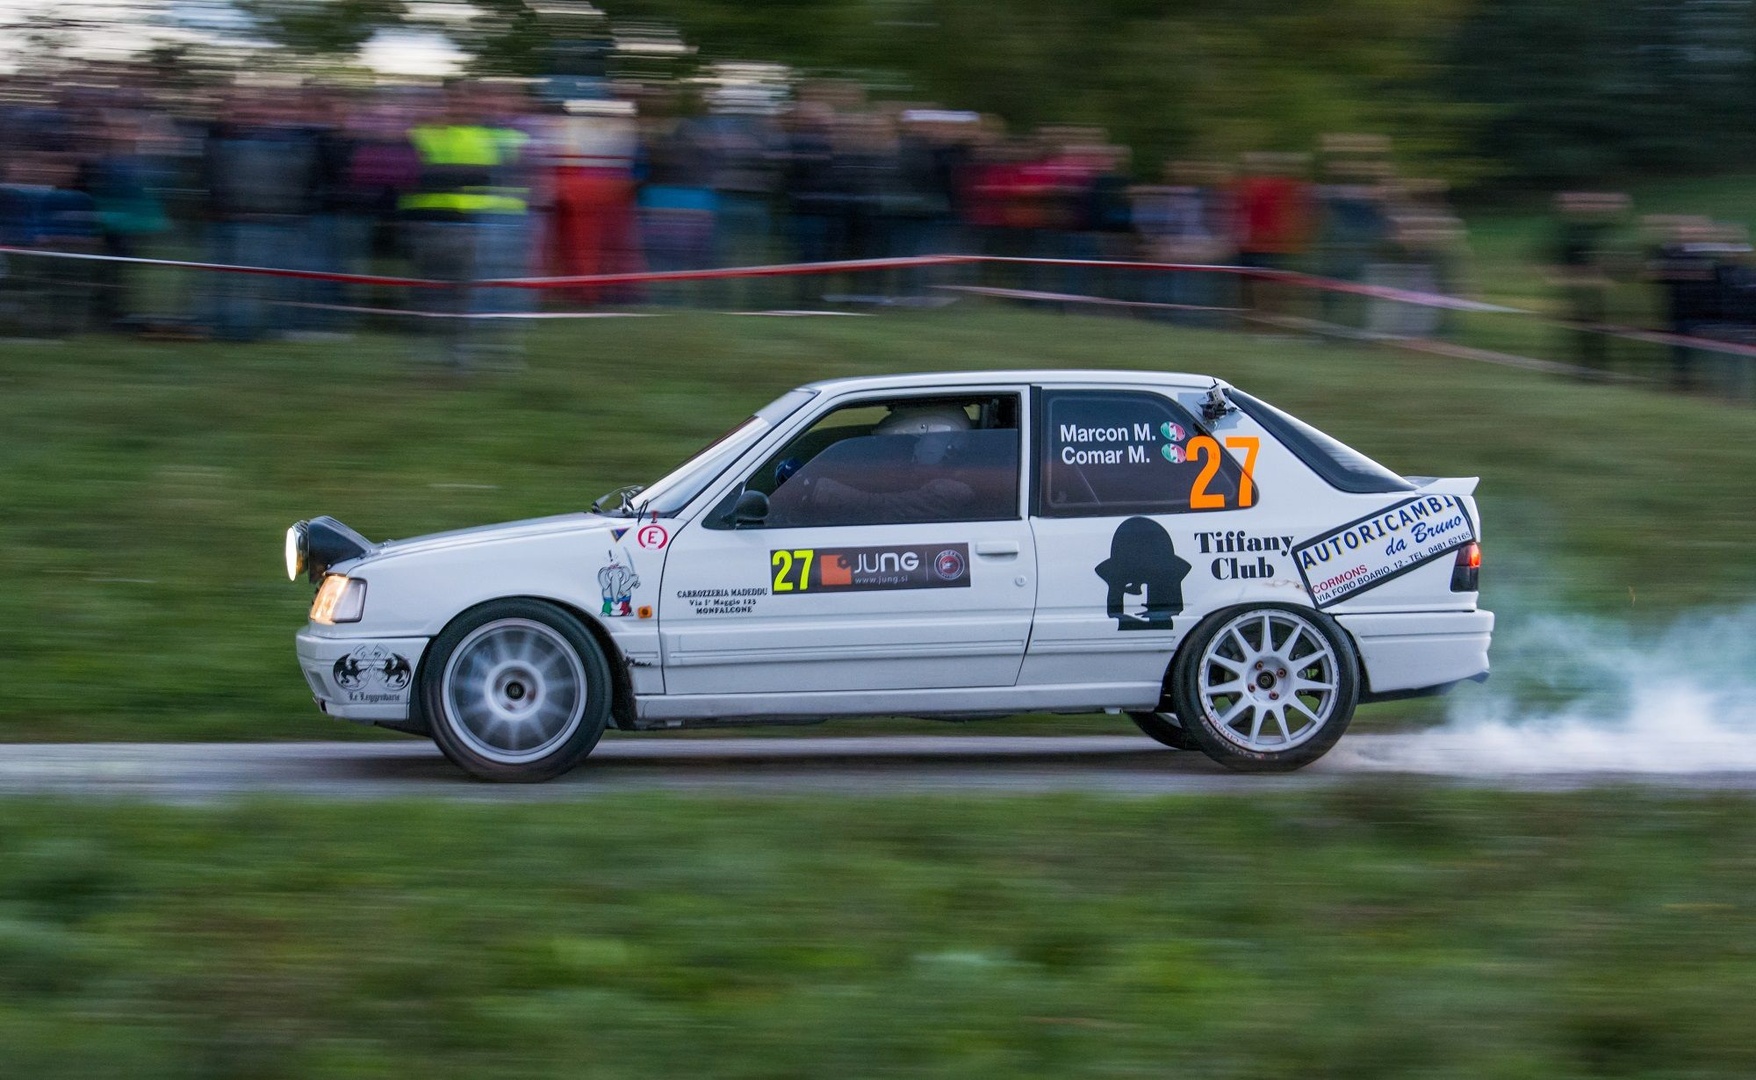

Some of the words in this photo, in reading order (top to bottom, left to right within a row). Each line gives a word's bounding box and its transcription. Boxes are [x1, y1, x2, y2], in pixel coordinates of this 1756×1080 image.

[1060, 424, 1128, 442] Marcon
[1133, 423, 1156, 441] M.
[1061, 446, 1123, 464] Comar
[1128, 445, 1150, 463] M.
[1186, 436, 1259, 508] 27
[1194, 530, 1294, 556] Tiffany
[1302, 496, 1453, 570] AUTORICAMBI
[1385, 536, 1408, 556] da
[1411, 514, 1463, 544] Bruno
[772, 550, 814, 591] 27
[854, 551, 920, 573] JUNG
[1211, 556, 1274, 580] Club
[1317, 592, 1332, 602] VIA
[1331, 580, 1356, 596] FORO
[1394, 559, 1403, 569] 12
[1428, 541, 1447, 554] 0481
[1448, 532, 1471, 545] 62165
[855, 576, 908, 585] www.jung.si
[1312, 564, 1368, 594] CORMONS
[677, 589, 729, 598] CARROZZERIA
[713, 599, 741, 607] Maggio
[696, 606, 753, 614] MONFALCONE
